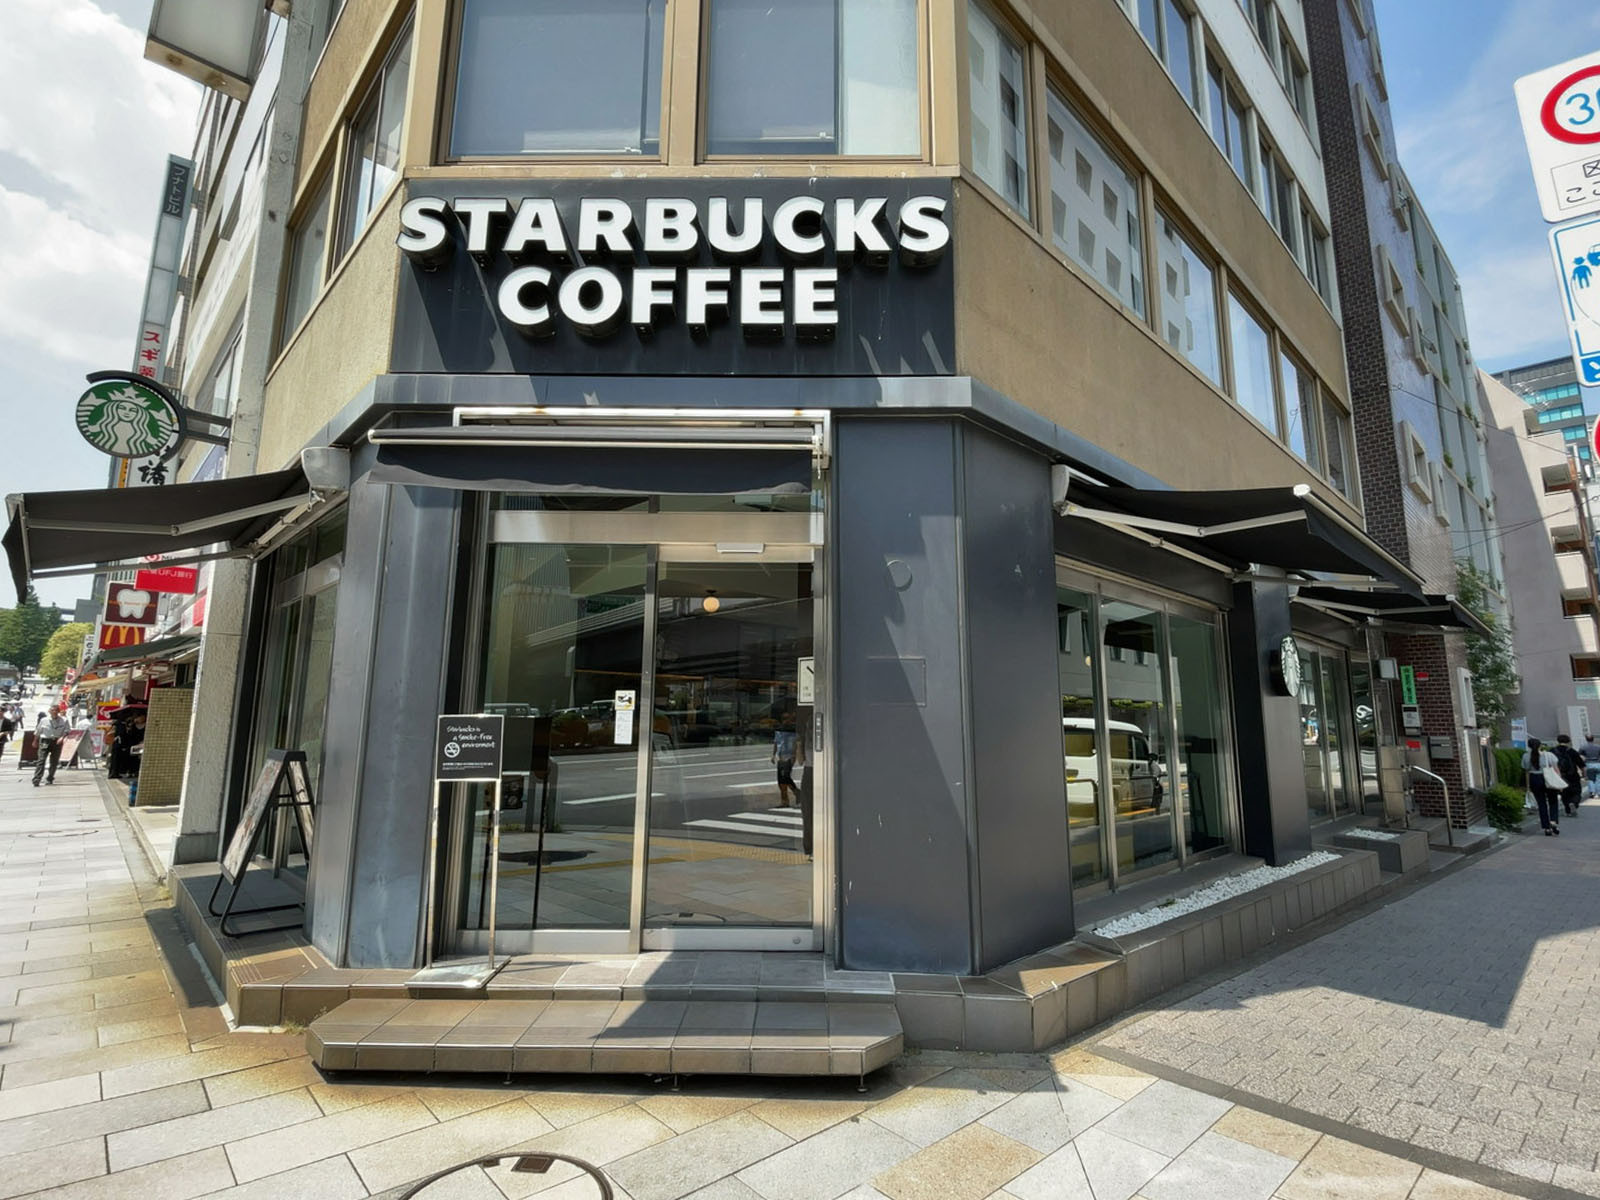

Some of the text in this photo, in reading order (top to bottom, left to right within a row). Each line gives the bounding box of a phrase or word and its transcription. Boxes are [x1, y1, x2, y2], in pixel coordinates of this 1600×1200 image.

[1565, 87, 1600, 126] 3
[397, 196, 951, 257] STARBUCKS
[498, 265, 839, 327] COFFEE
